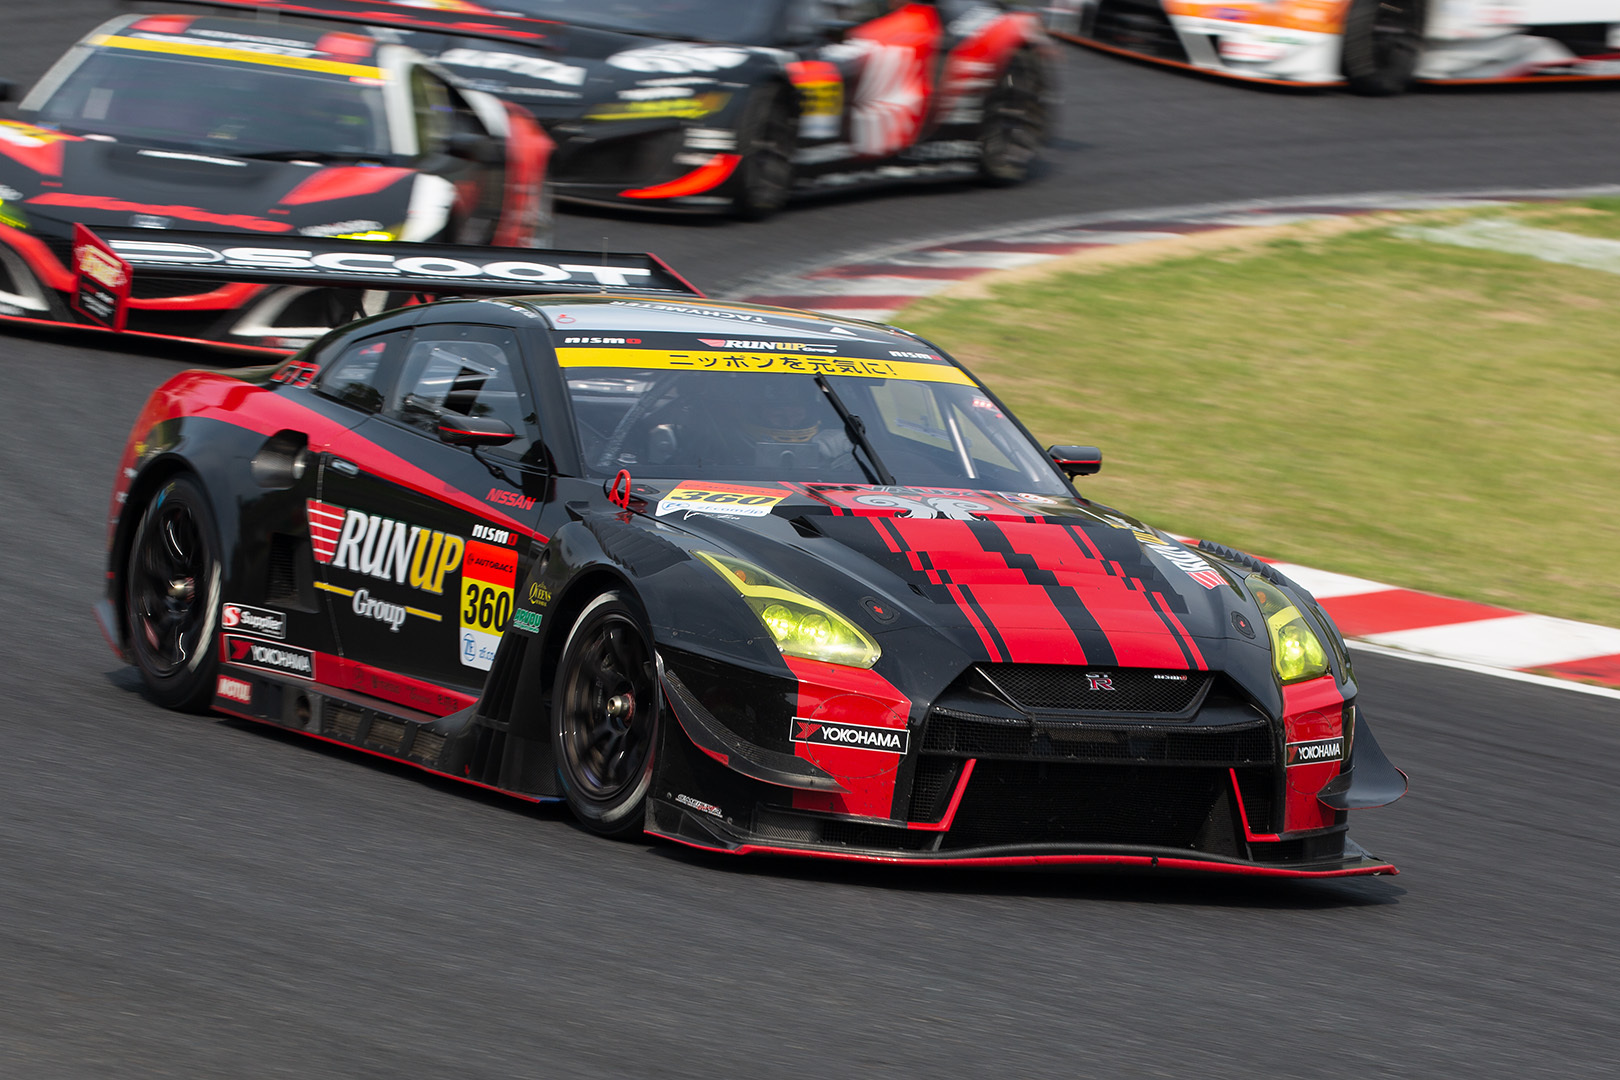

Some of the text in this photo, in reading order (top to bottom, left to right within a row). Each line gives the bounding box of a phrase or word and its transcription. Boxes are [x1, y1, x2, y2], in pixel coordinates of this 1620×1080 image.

[609, 300, 768, 324] TACHYMETER
[485, 488, 536, 511] NISSAN
[671, 489, 777, 506] 360
[332, 509, 466, 596] RUNUP
[474, 557, 514, 574] AUTOBACS
[352, 588, 407, 633] Group
[464, 583, 511, 633] 360
[240, 611, 284, 631] Supplier
[251, 644, 312, 673] YOKOHAMA
[821, 725, 902, 749] YOKOHAMA
[1297, 742, 1341, 761] YOKOHAMA
